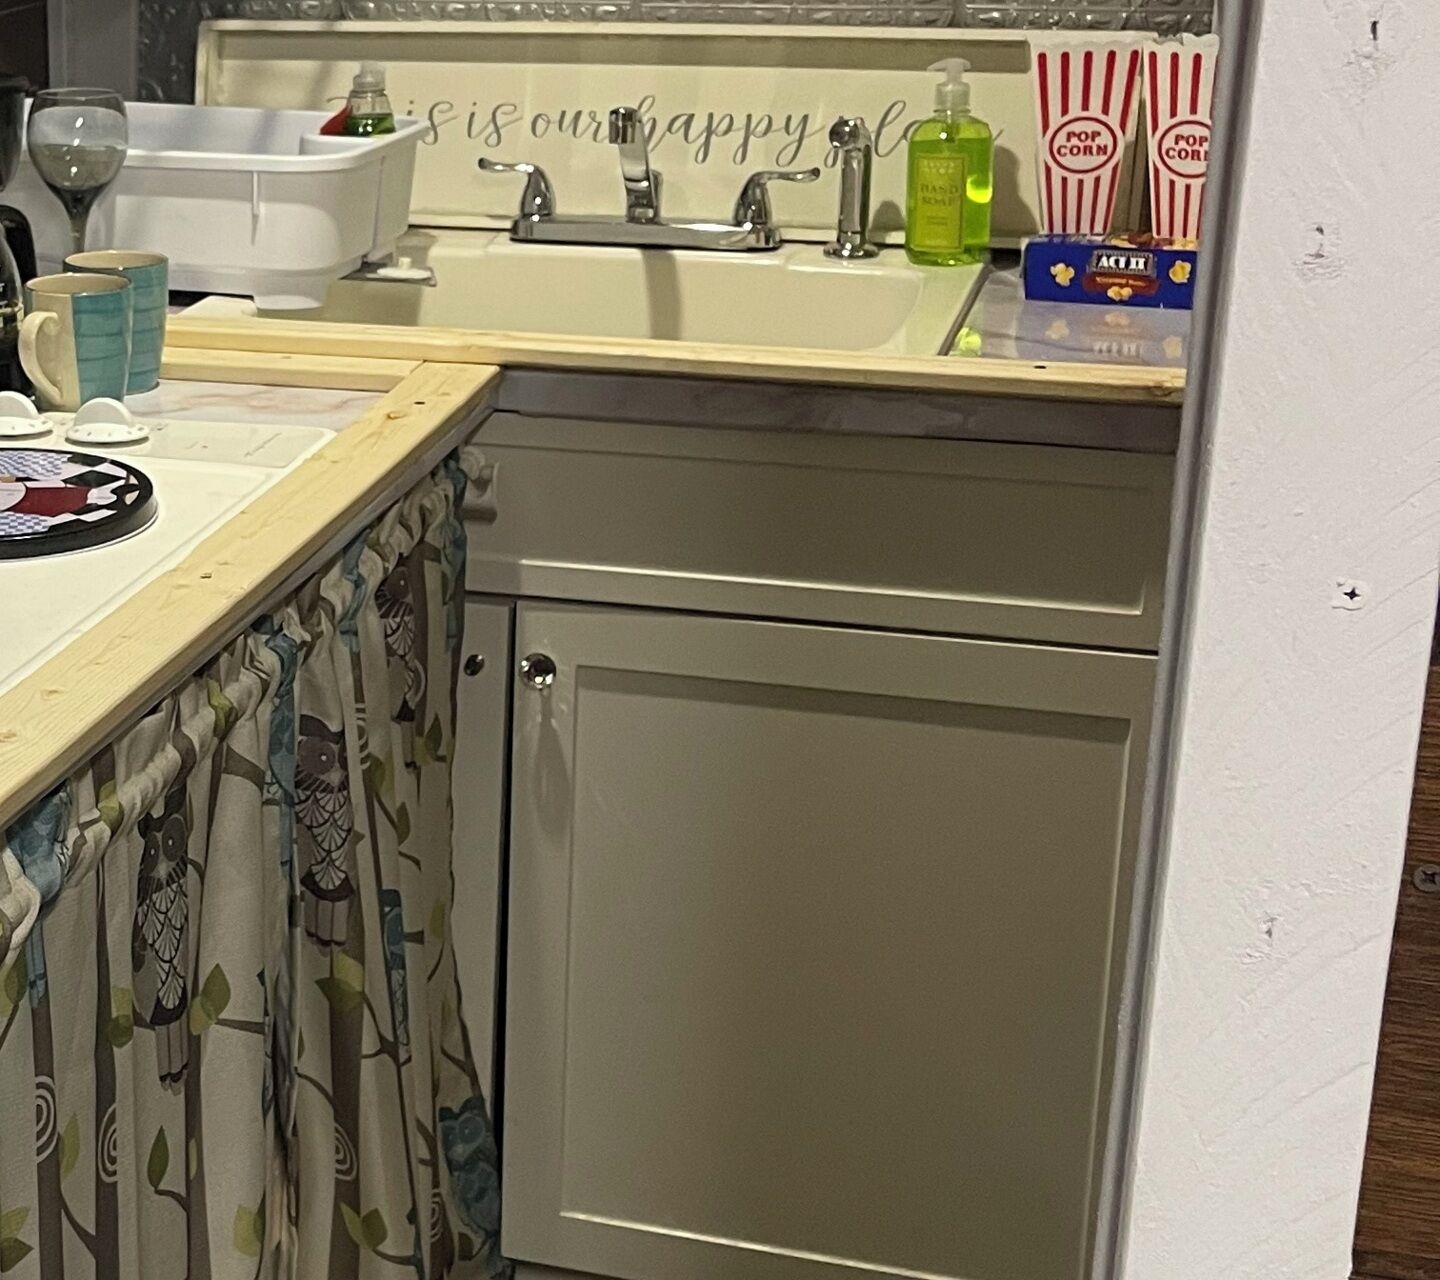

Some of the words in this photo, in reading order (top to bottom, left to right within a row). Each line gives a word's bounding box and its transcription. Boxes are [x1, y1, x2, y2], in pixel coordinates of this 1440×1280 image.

[467, 102, 523, 147] is
[530, 109, 610, 144] our
[1066, 131, 1101, 143] POP
[1174, 134, 1209, 146] POP
[1056, 144, 1108, 157] CORN
[920, 184, 958, 194] HAND
[1099, 256, 1126, 269] ACT
